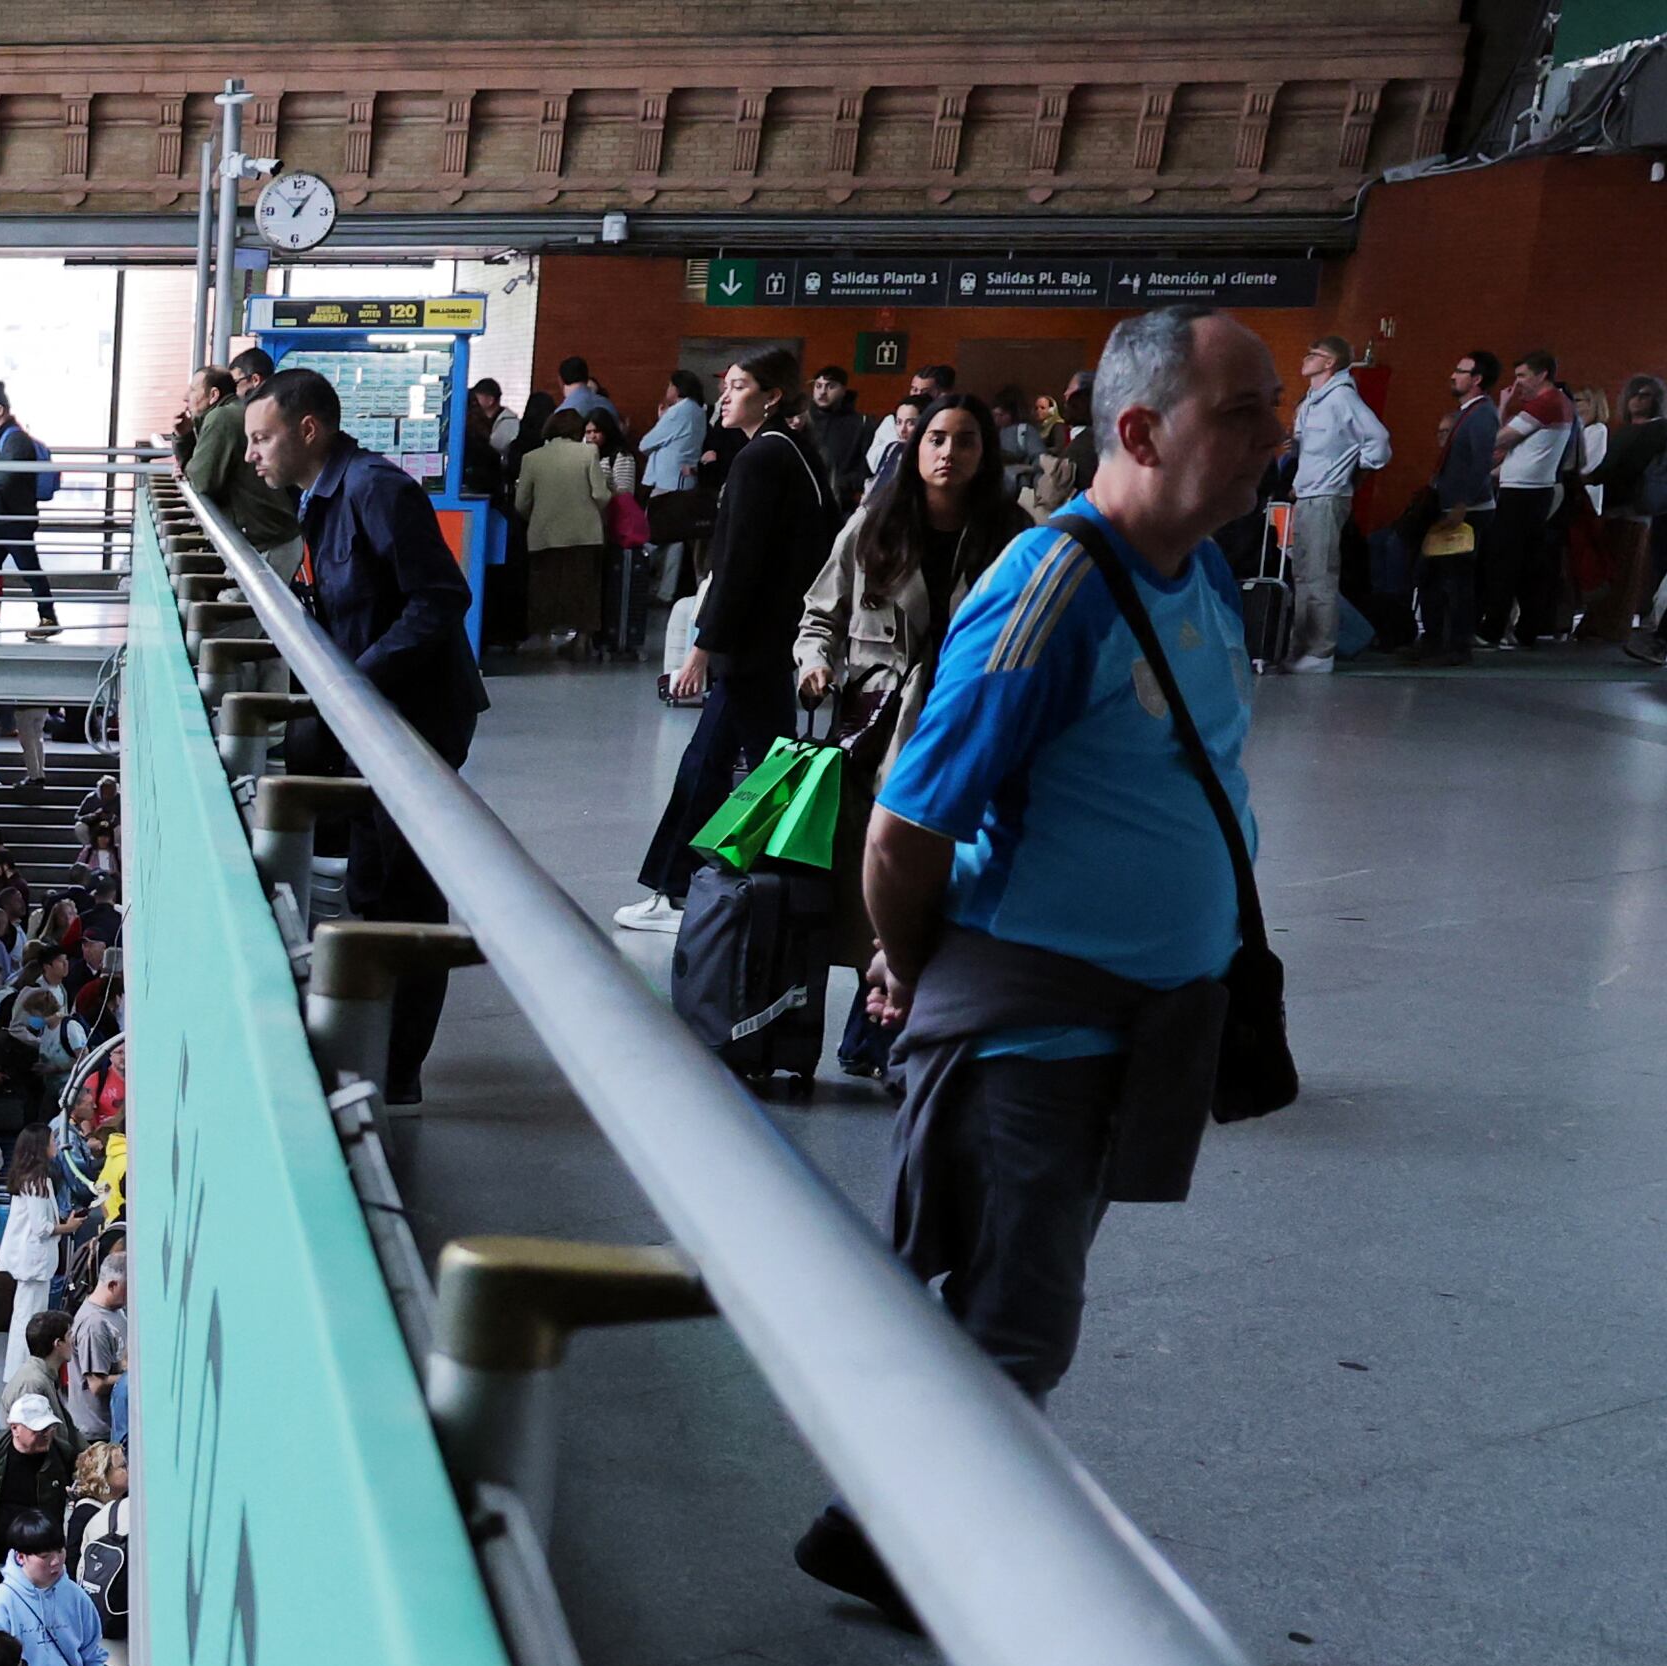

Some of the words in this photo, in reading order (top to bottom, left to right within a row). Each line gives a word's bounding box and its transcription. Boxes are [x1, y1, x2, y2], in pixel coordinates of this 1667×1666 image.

[293, 180, 306, 190] 12
[266, 207, 275, 216] 9
[319, 207, 328, 216] 3
[291, 234, 299, 243] 6
[831, 271, 880, 285] Salidas
[883, 271, 926, 285] Planta
[930, 271, 939, 285] 1
[986, 271, 1036, 285] Salidas
[1038, 271, 1057, 285] Pl.
[1061, 271, 1091, 287] Baja
[1147, 271, 1209, 285] Atención
[1212, 272, 1226, 285] al
[1230, 272, 1278, 285] cliente
[389, 304, 417, 318] 120
